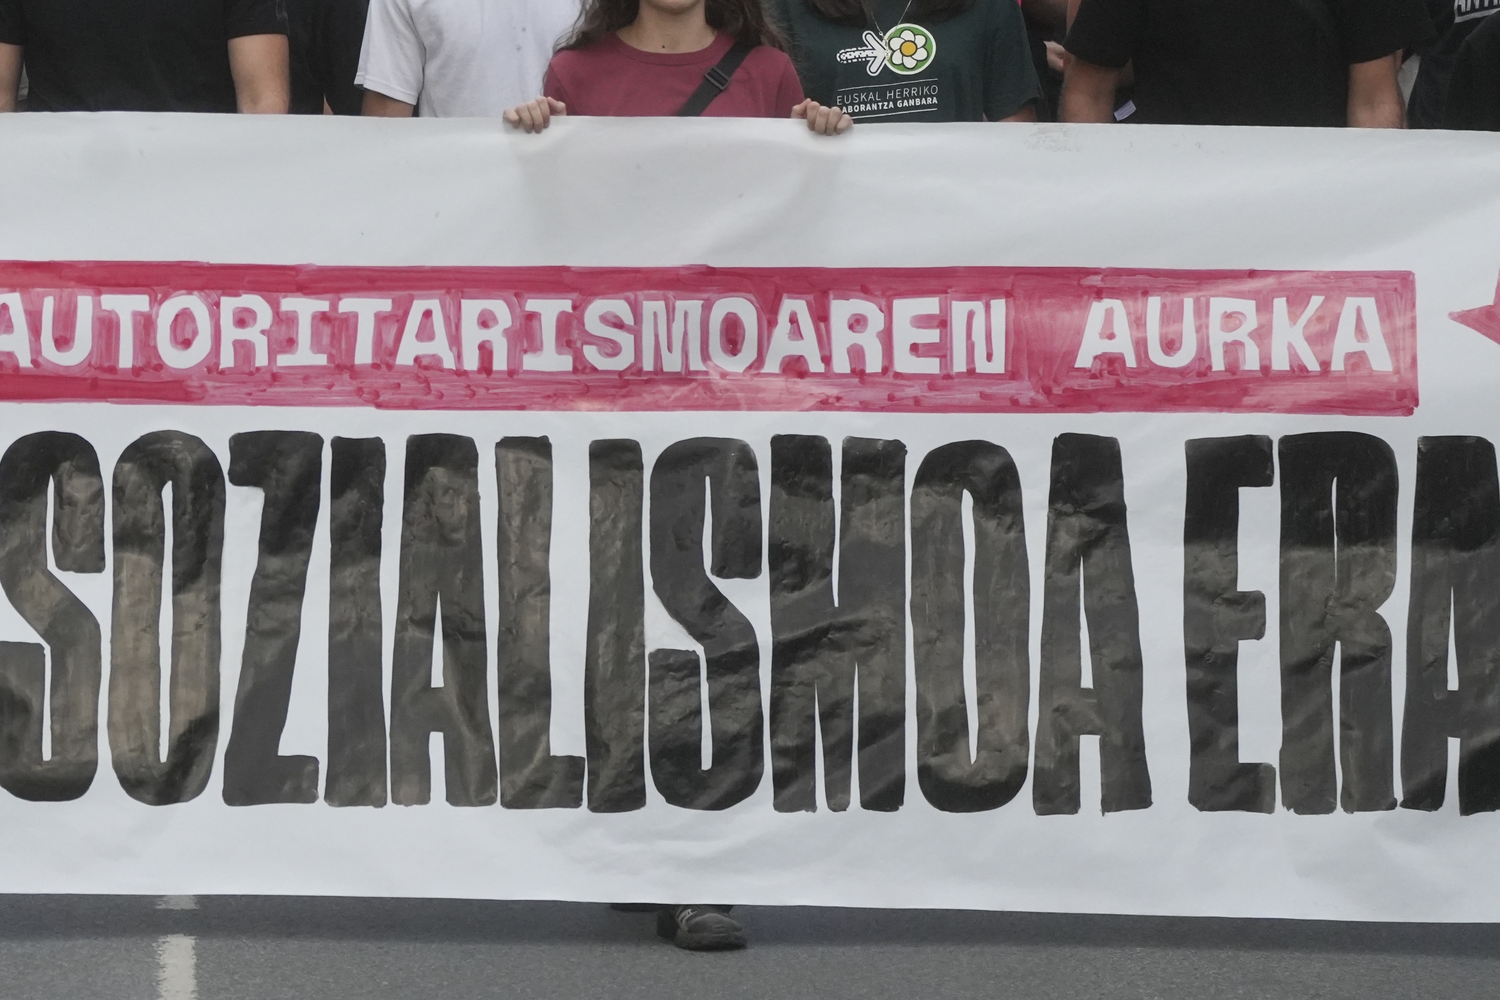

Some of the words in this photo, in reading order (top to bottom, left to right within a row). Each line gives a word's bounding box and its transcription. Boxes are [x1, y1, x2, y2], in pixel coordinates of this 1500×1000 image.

[836, 92, 881, 106] EUSKAL
[887, 85, 938, 100] HERRIKO
[841, 102, 894, 114] ABORANTZA
[897, 96, 938, 108] GANBARA
[1075, 295, 1393, 372] AURKA
[1183, 431, 1500, 816] ERA
